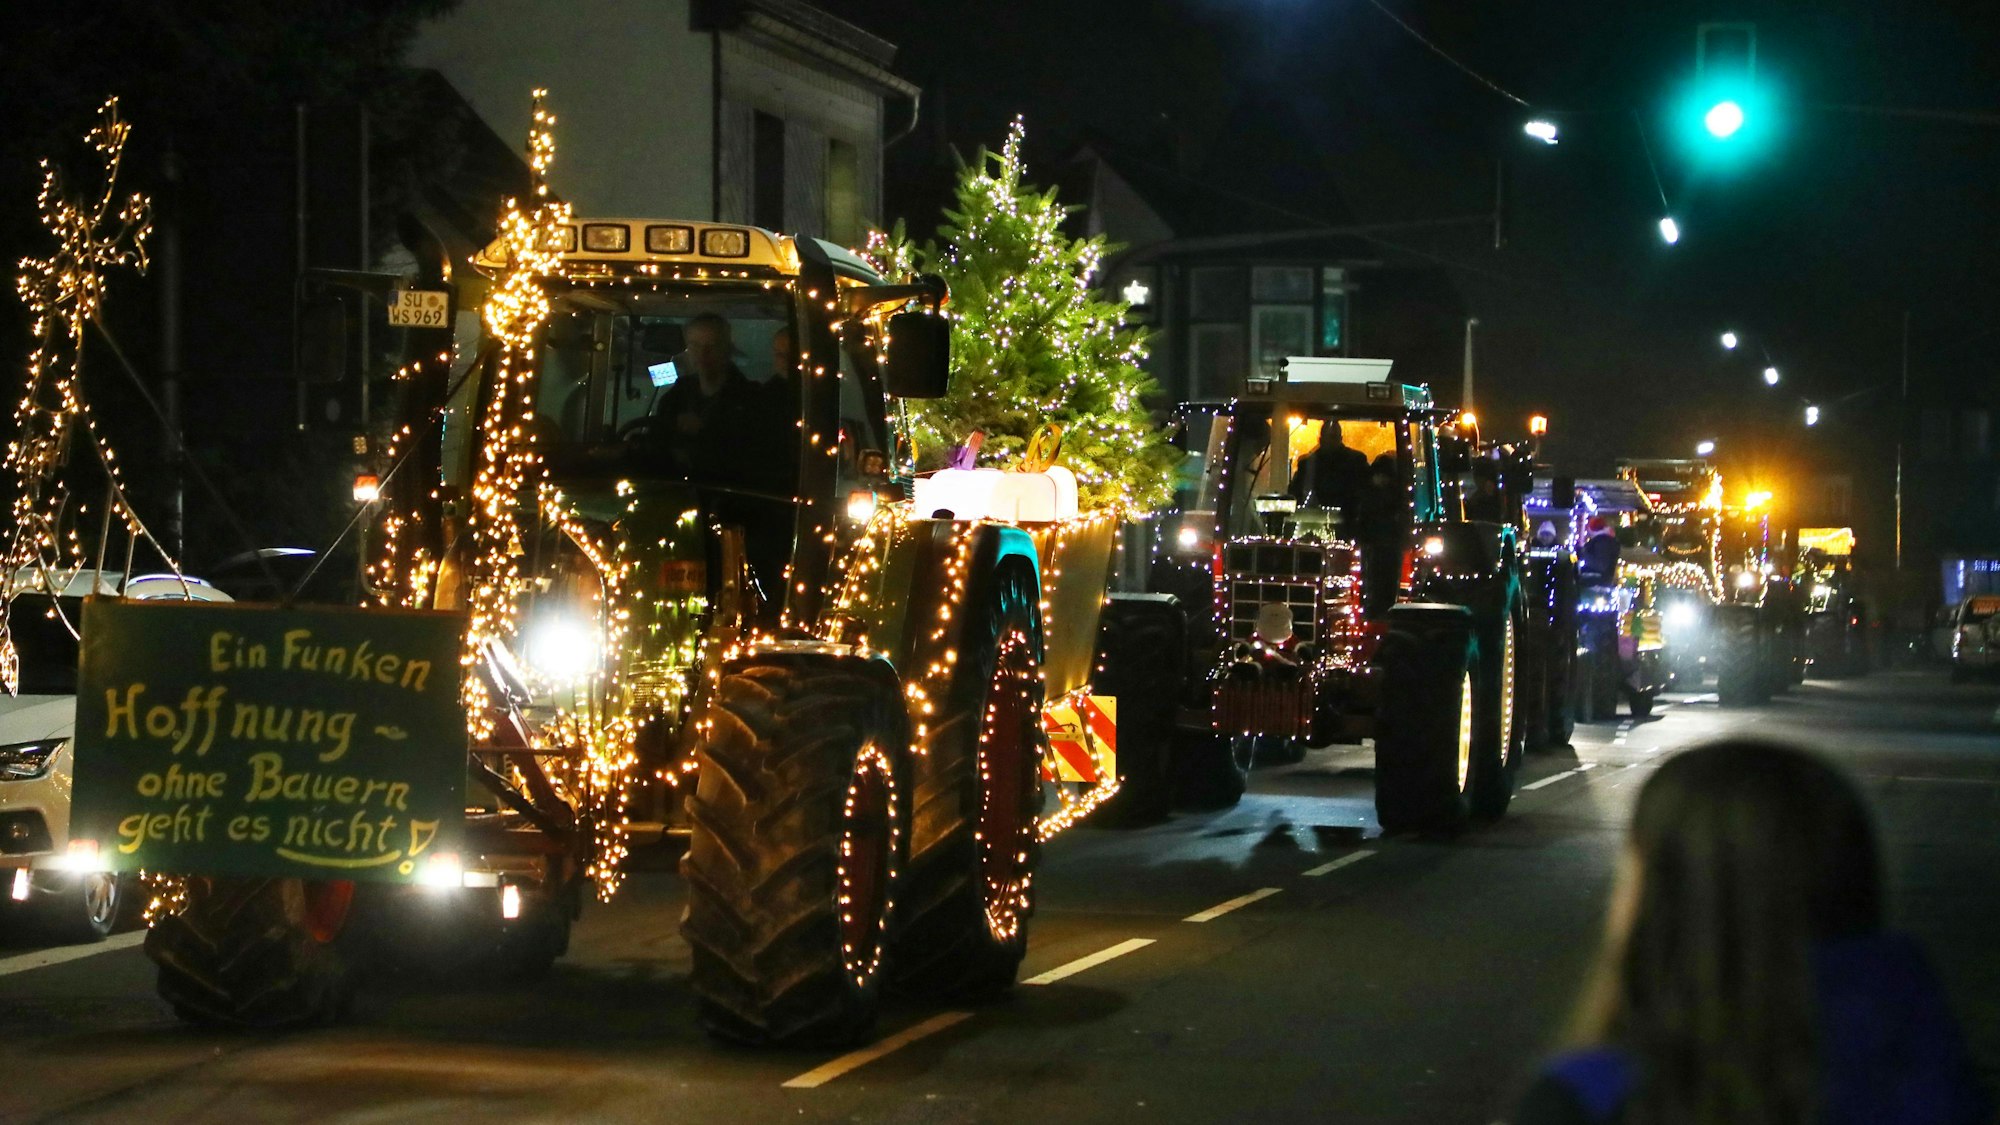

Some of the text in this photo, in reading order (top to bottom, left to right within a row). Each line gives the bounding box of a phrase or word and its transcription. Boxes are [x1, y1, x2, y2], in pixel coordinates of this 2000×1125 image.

[391, 307, 442, 325] WS 969
[404, 292, 422, 308] SU
[209, 628, 432, 691] Ein Funken
[105, 682, 358, 763] Hoffnung
[137, 751, 411, 812] ohne Bauern
[117, 803, 214, 855] geht
[227, 815, 270, 843] es
